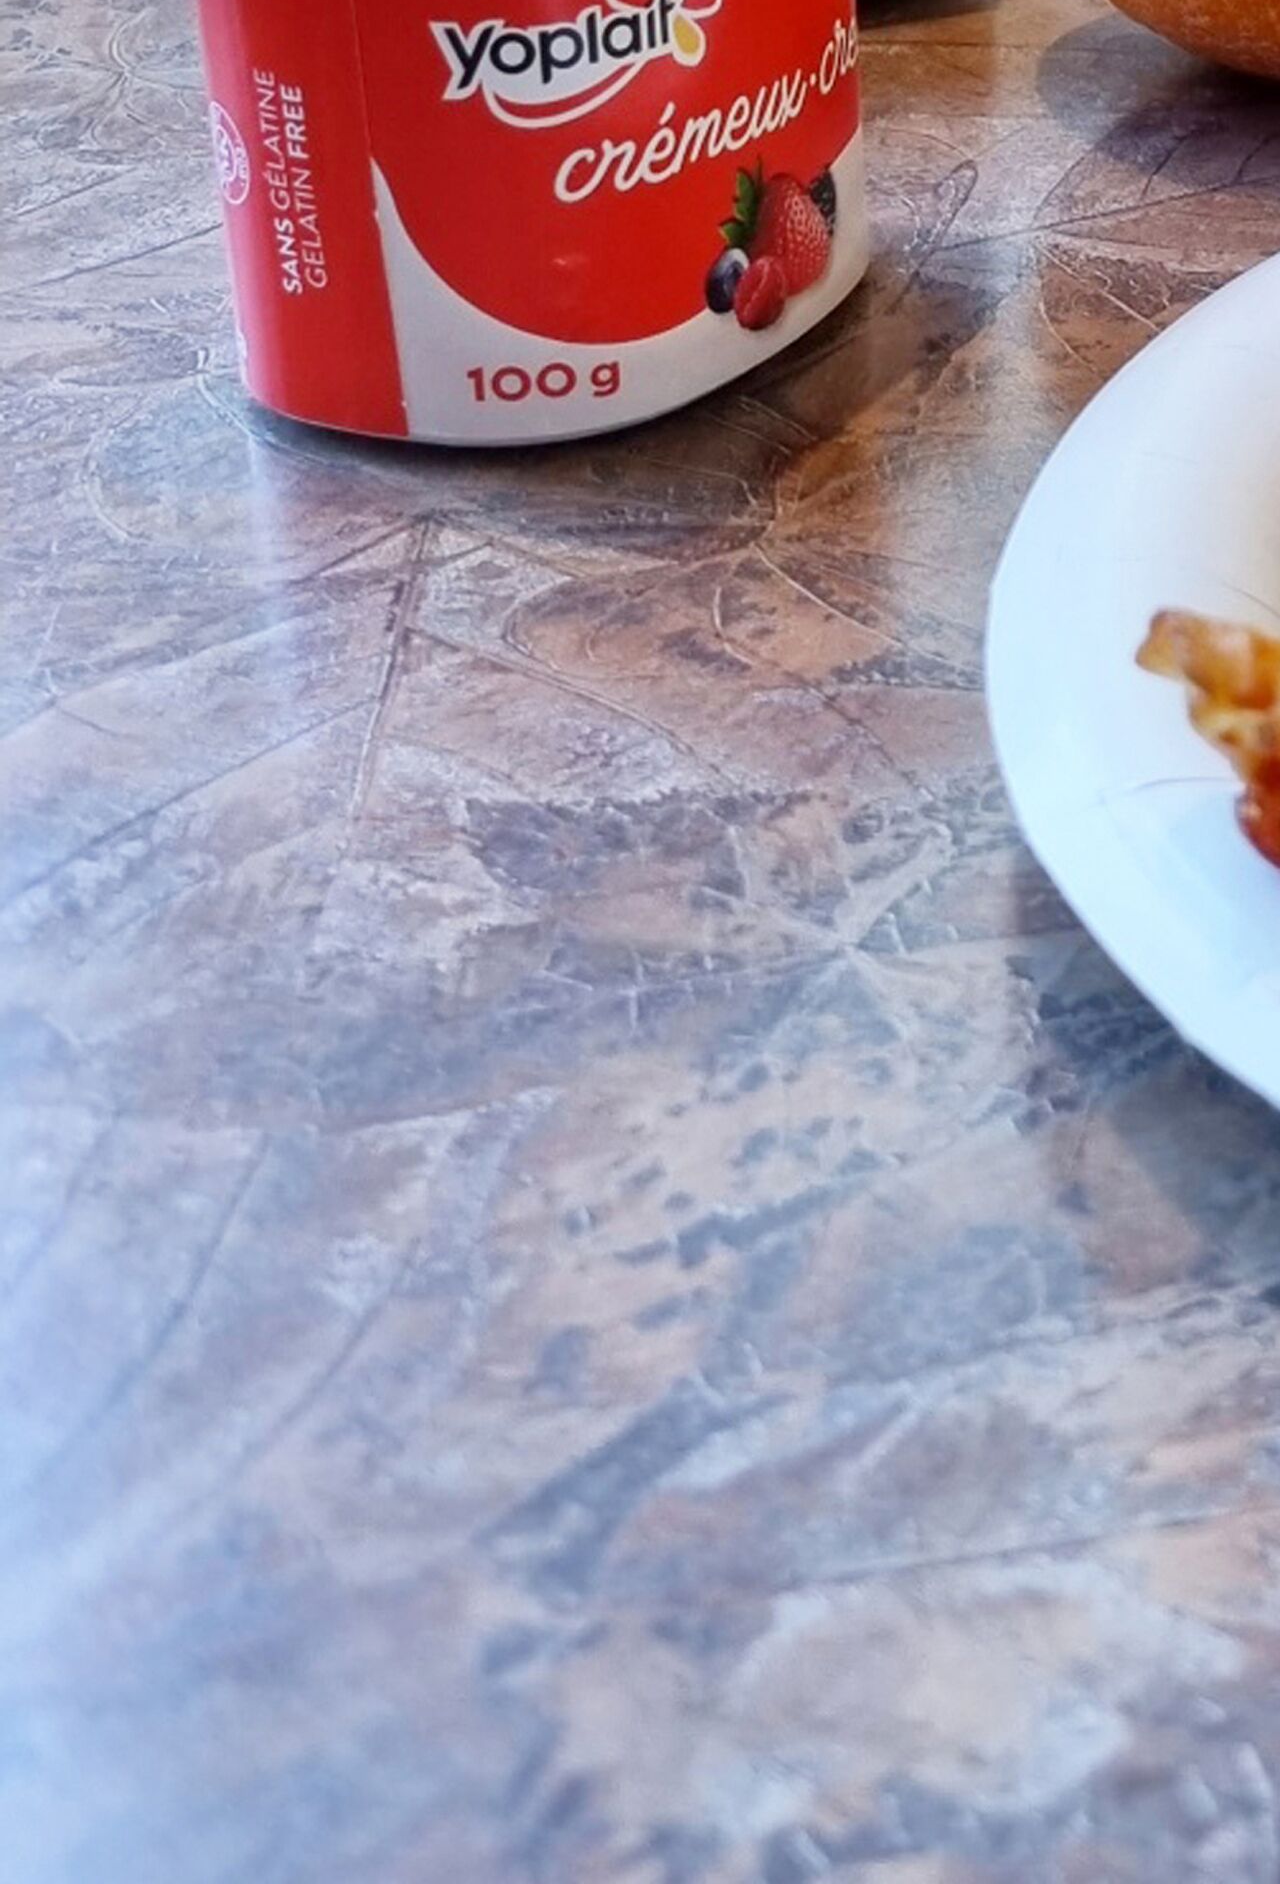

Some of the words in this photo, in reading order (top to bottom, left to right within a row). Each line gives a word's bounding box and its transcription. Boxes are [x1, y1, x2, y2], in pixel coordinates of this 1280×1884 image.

[253, 68, 293, 212] GÉLATINE
[280, 83, 310, 161] FREE
[274, 217, 303, 296] SANS
[294, 166, 328, 289] GELATIN
[466, 362, 578, 403] 100
[590, 361, 621, 398] g
